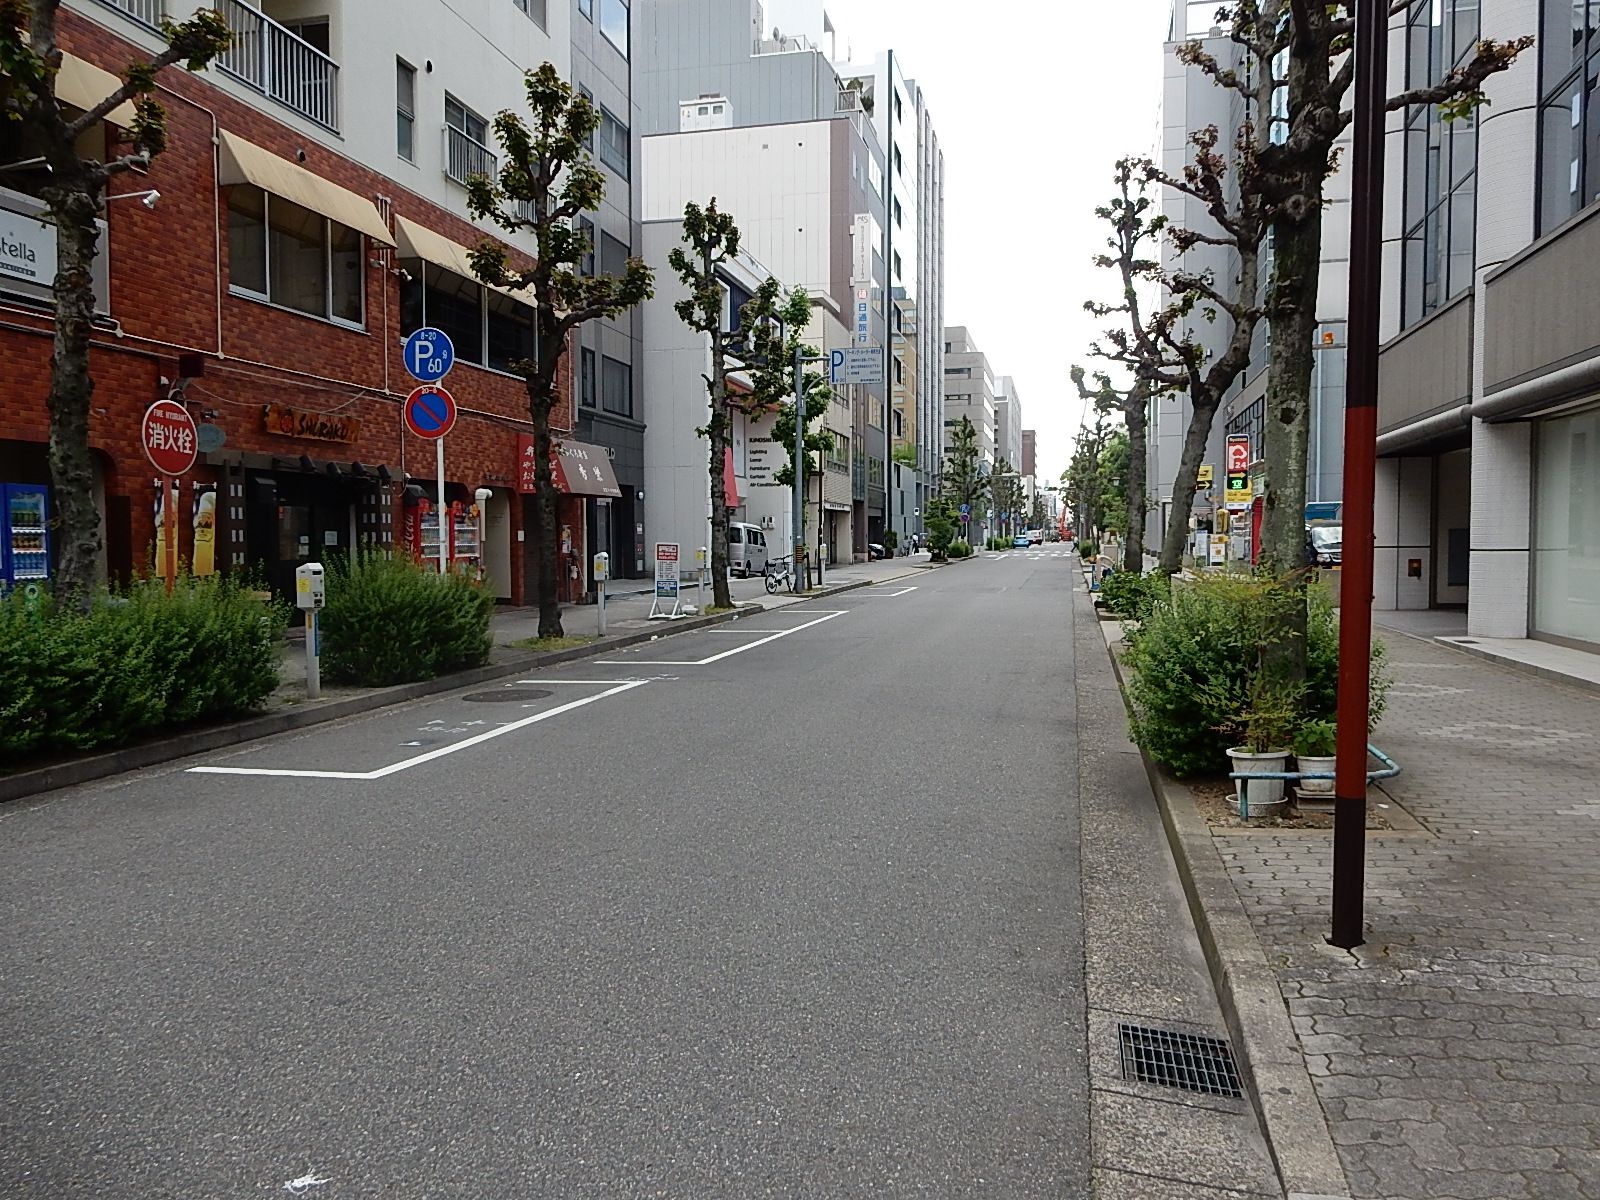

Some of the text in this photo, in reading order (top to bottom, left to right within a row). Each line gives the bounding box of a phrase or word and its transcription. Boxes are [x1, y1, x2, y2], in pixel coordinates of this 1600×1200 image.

[420, 331, 437, 341] 8-20
[858, 302, 867, 343] 日通旅行
[415, 340, 434, 374] P
[831, 350, 845, 383] P
[153, 408, 188, 422] FIRE HYDRANT
[297, 412, 349, 440] SHURAKU
[148, 421, 193, 455] 消火栓
[1235, 461, 1247, 469] 24
